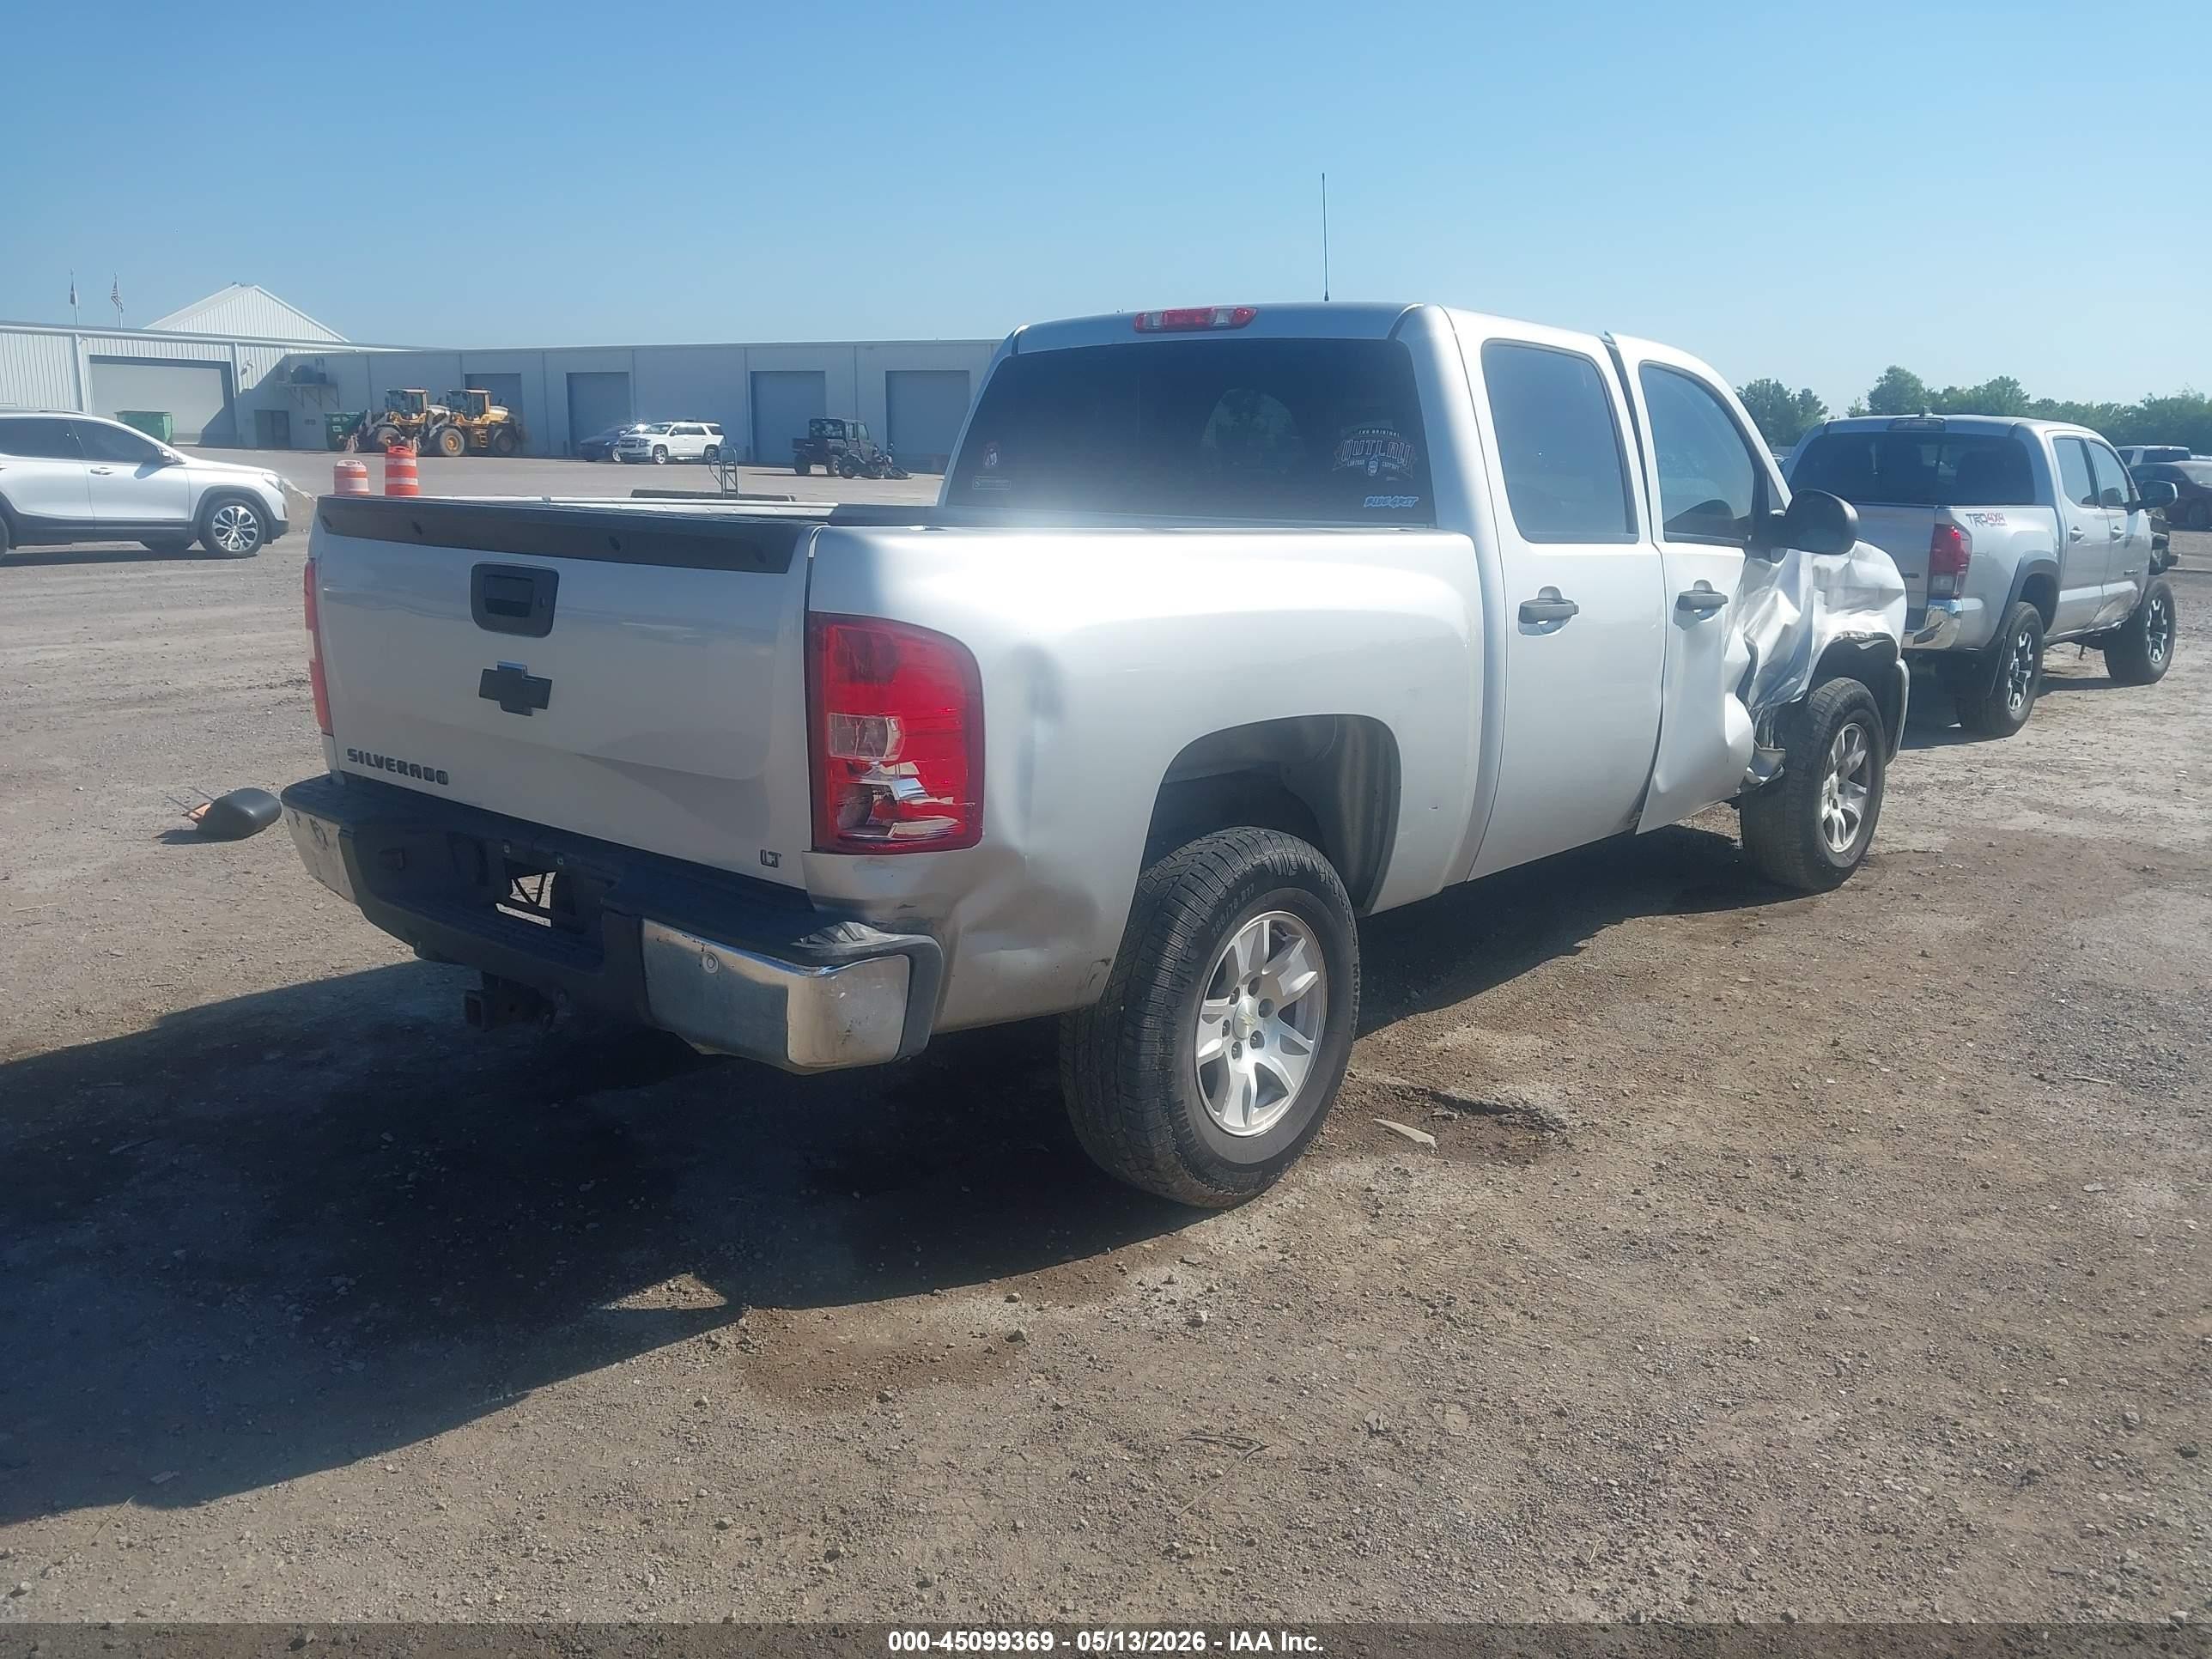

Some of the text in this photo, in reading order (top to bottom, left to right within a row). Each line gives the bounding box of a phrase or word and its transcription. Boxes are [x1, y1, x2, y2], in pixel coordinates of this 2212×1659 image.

[1341, 440, 1411, 466] OUTLAW
[347, 748, 449, 786] SILVERADO
[760, 849, 781, 868] LT
